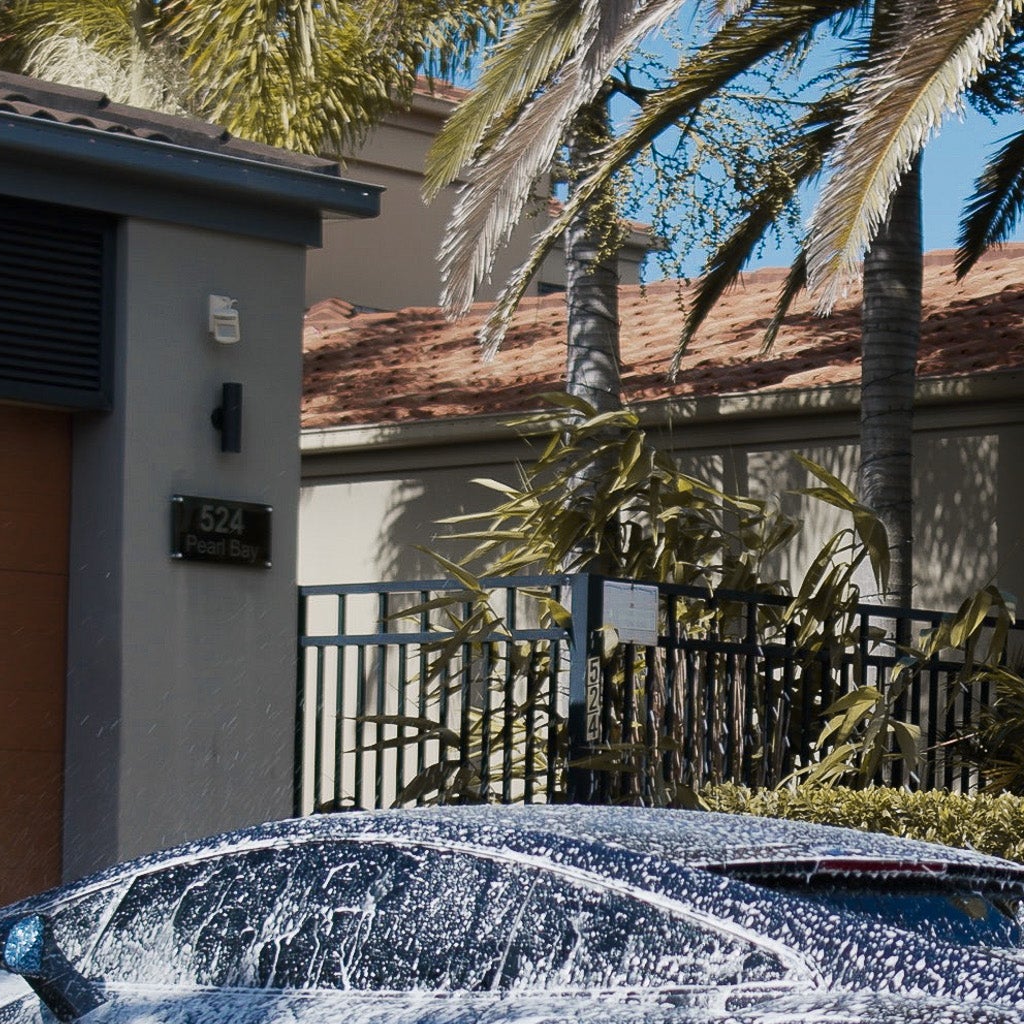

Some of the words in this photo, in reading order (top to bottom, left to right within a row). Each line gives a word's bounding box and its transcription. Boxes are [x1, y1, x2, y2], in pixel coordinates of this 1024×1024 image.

[200, 505, 245, 535] 524
[186, 534, 226, 555] Pearl
[230, 539, 259, 563] Bay
[588, 658, 599, 738] 524
